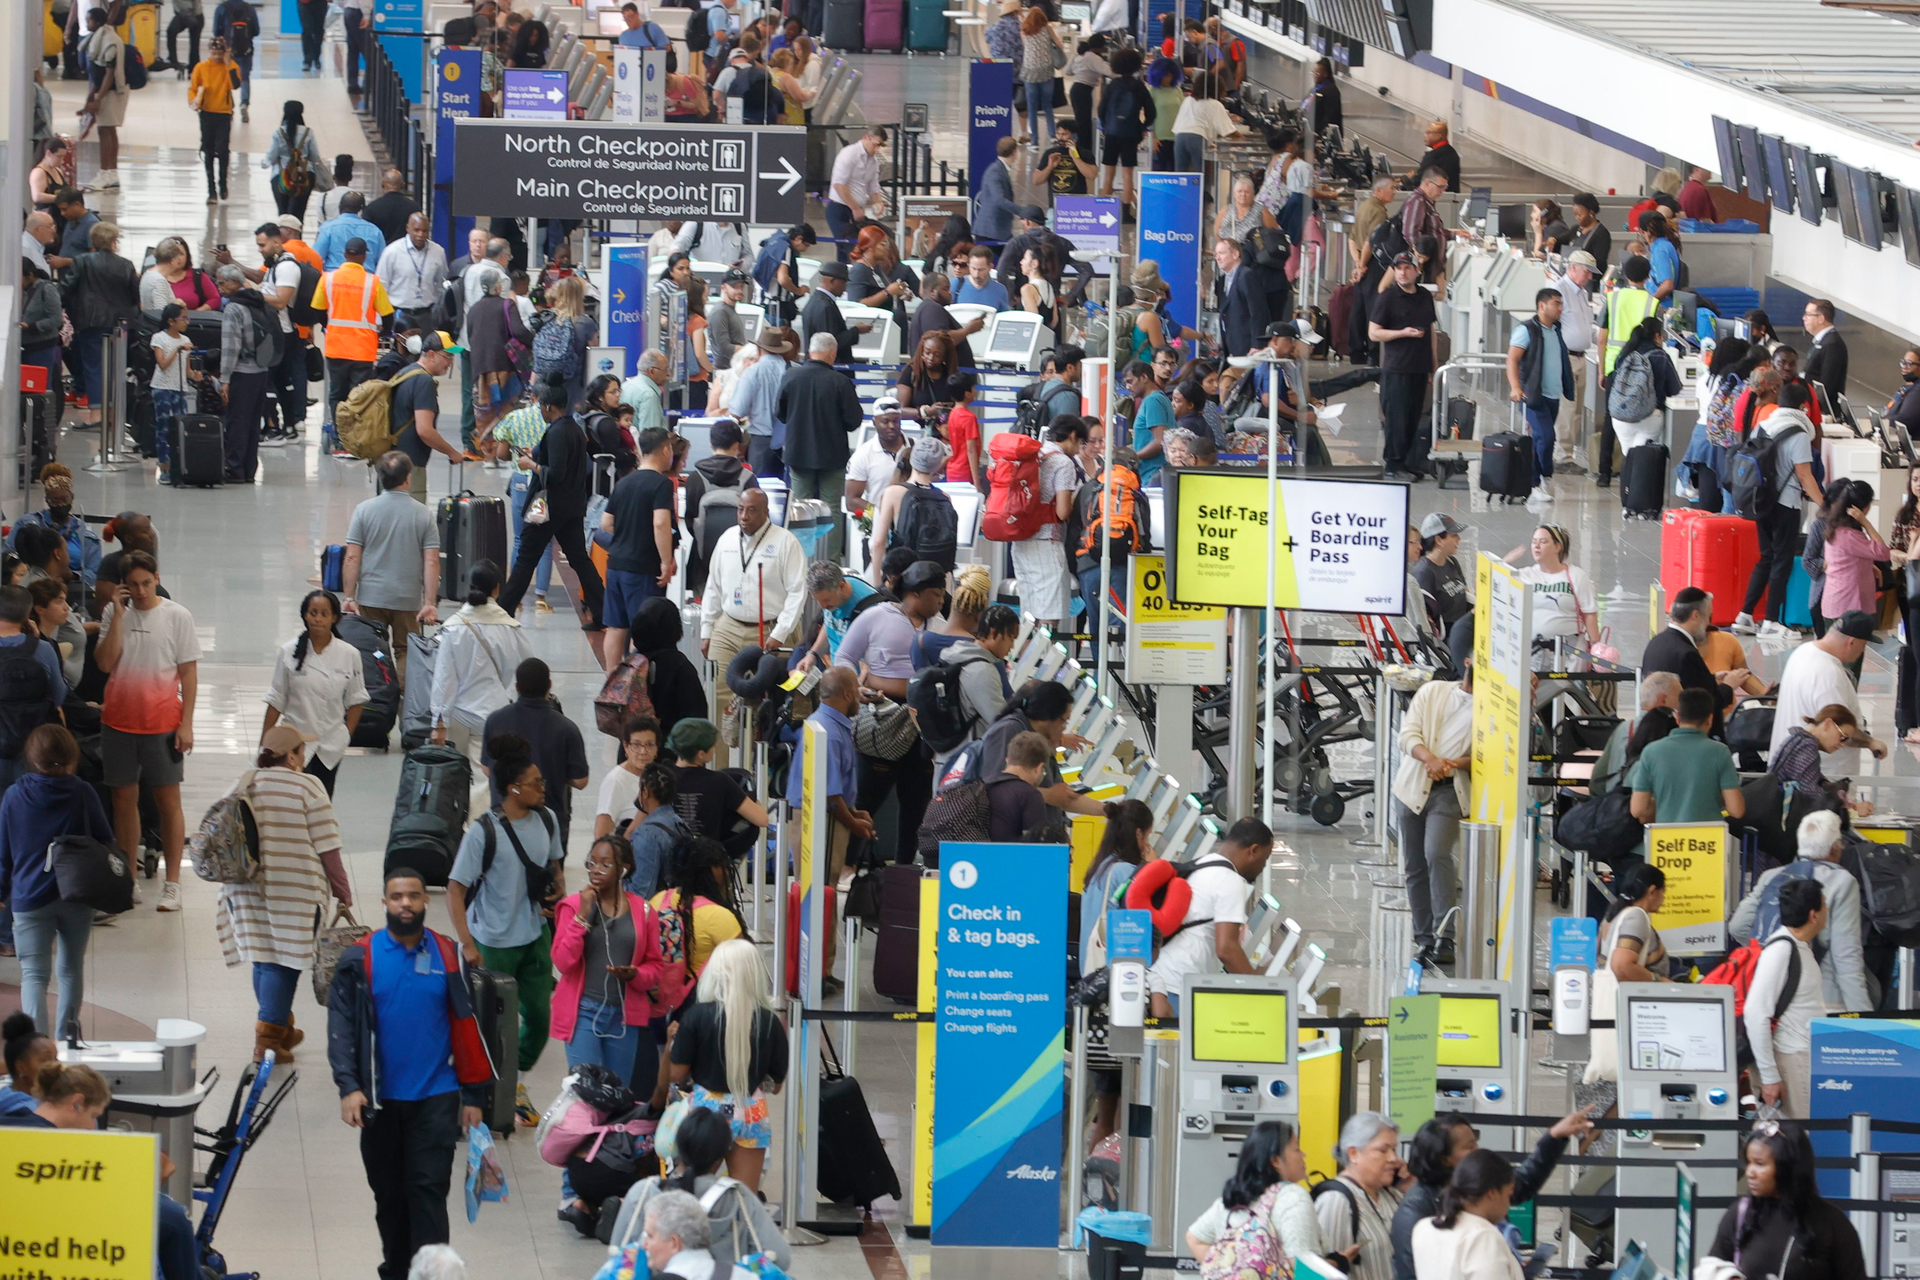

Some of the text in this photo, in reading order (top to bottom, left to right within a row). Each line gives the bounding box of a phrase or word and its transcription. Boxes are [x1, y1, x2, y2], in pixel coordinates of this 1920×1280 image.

[442, 91, 470, 104] Start
[442, 107, 470, 119] Here
[975, 105, 1010, 117] Priority
[975, 119, 997, 128] Lane
[504, 134, 709, 159] North Checkpoint
[547, 157, 709, 173] Control de Seguridad Norte
[516, 178, 708, 203] Main Checkpoint
[583, 201, 708, 217] Control de Seguridad
[1144, 229, 1194, 243] Bag Drop
[1198, 505, 1268, 525] Self-Tag
[1311, 511, 1387, 529] Get Your
[1197, 524, 1238, 539] Your
[1311, 530, 1390, 551] Boarding
[1197, 542, 1230, 561] Bag
[1311, 549, 1350, 563] Pass
[1142, 596, 1163, 610] 40
[1364, 595, 1392, 604] spirit
[1656, 838, 1716, 854] Self Bag
[1656, 856, 1692, 870] Drop
[959, 868, 966, 881] 1
[947, 903, 1022, 921] Check in
[947, 928, 1041, 948] & tag bags.
[1684, 935, 1717, 945] spirit
[946, 968, 1013, 979] You can also:
[945, 990, 969, 1000] Print
[979, 991, 1025, 1003] boarding
[1026, 994, 1050, 1003] pass
[893, 1012, 919, 1020] spirit
[944, 1006, 1012, 1018] Change seats
[944, 1022, 1018, 1035] Change flights
[1363, 1018, 1389, 1026] spirit
[1820, 1046, 1850, 1054] Measure
[1851, 1047, 1867, 1056] your
[1817, 1079, 1854, 1091] Alaska
[15, 1159, 106, 1184] spirit
[1006, 1164, 1057, 1182] Alaska
[0, 1236, 126, 1266] Need help
